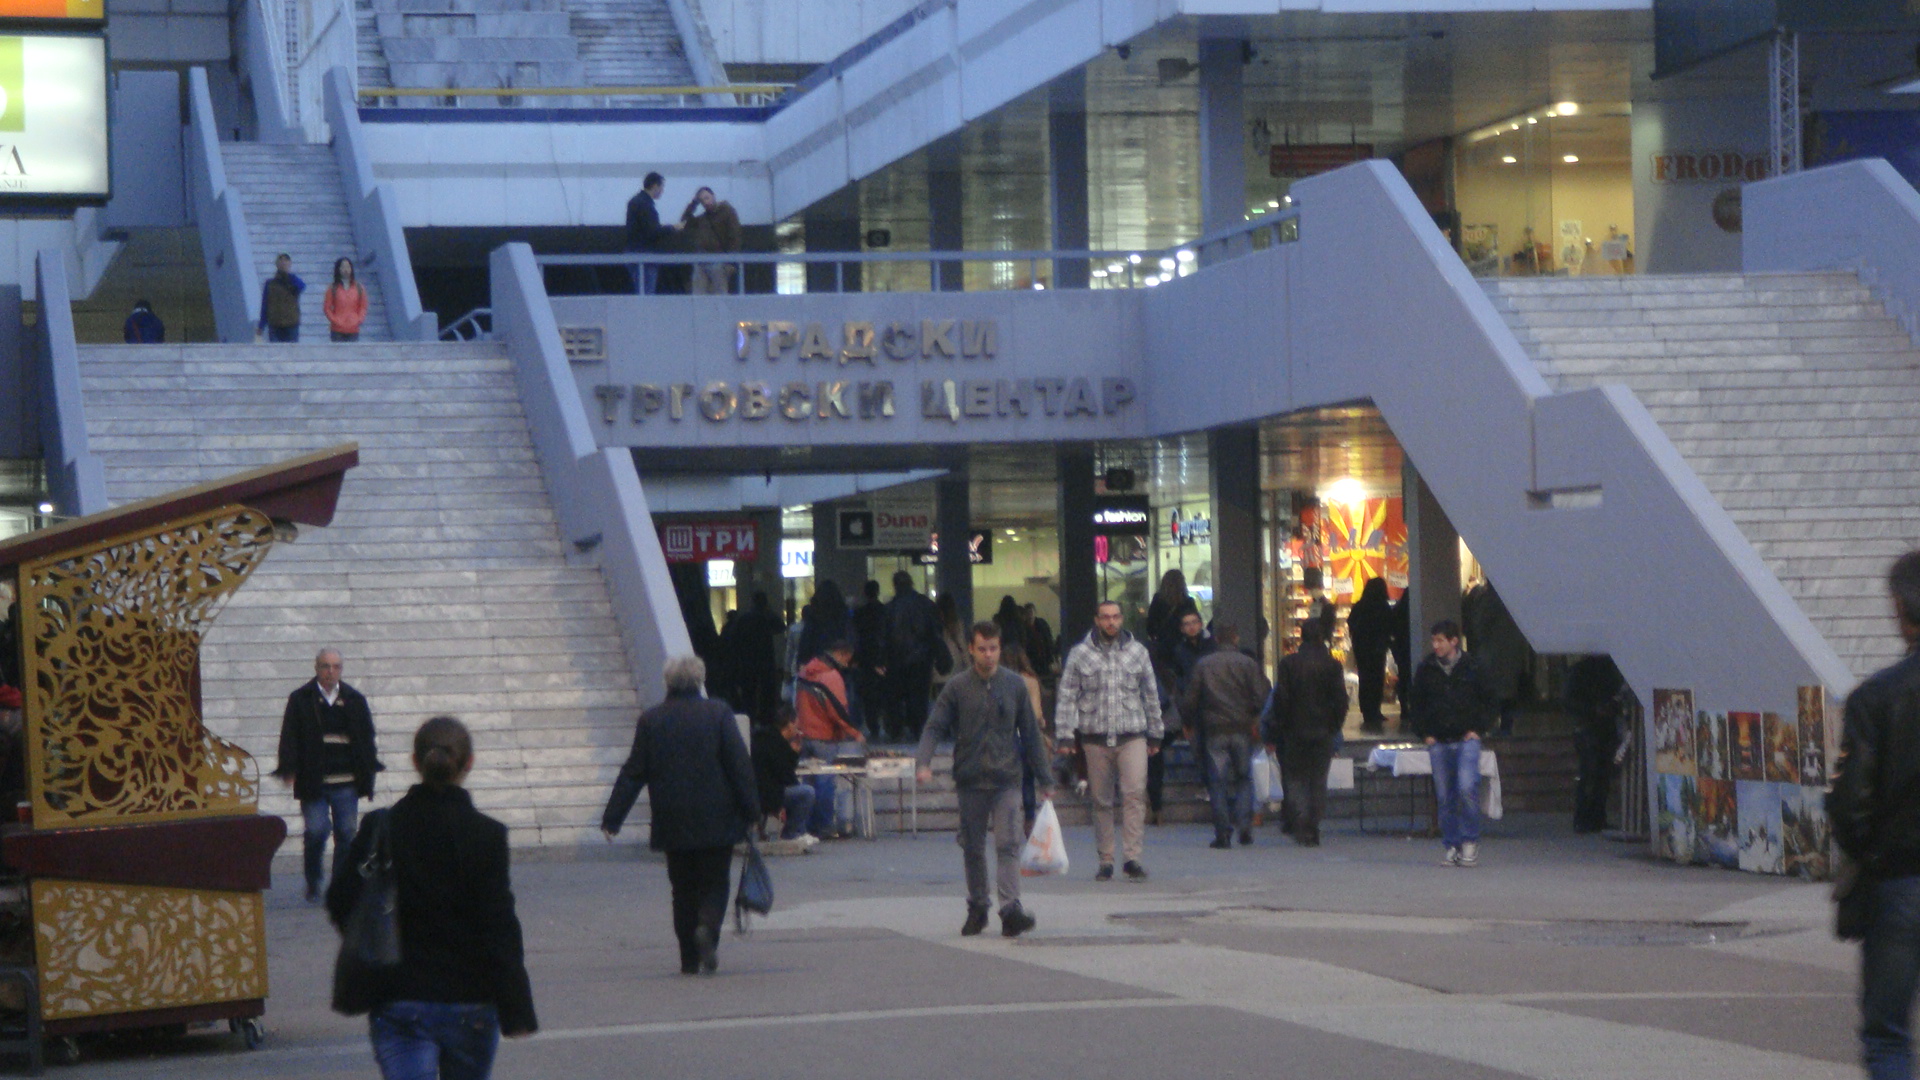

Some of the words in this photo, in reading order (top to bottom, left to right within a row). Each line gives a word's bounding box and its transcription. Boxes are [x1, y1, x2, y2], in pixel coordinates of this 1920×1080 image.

[736, 321, 998, 367] ГРАДСКИ
[594, 381, 895, 424] ТРГОВСКИ
[920, 377, 1136, 424] ЦЕНТАР
